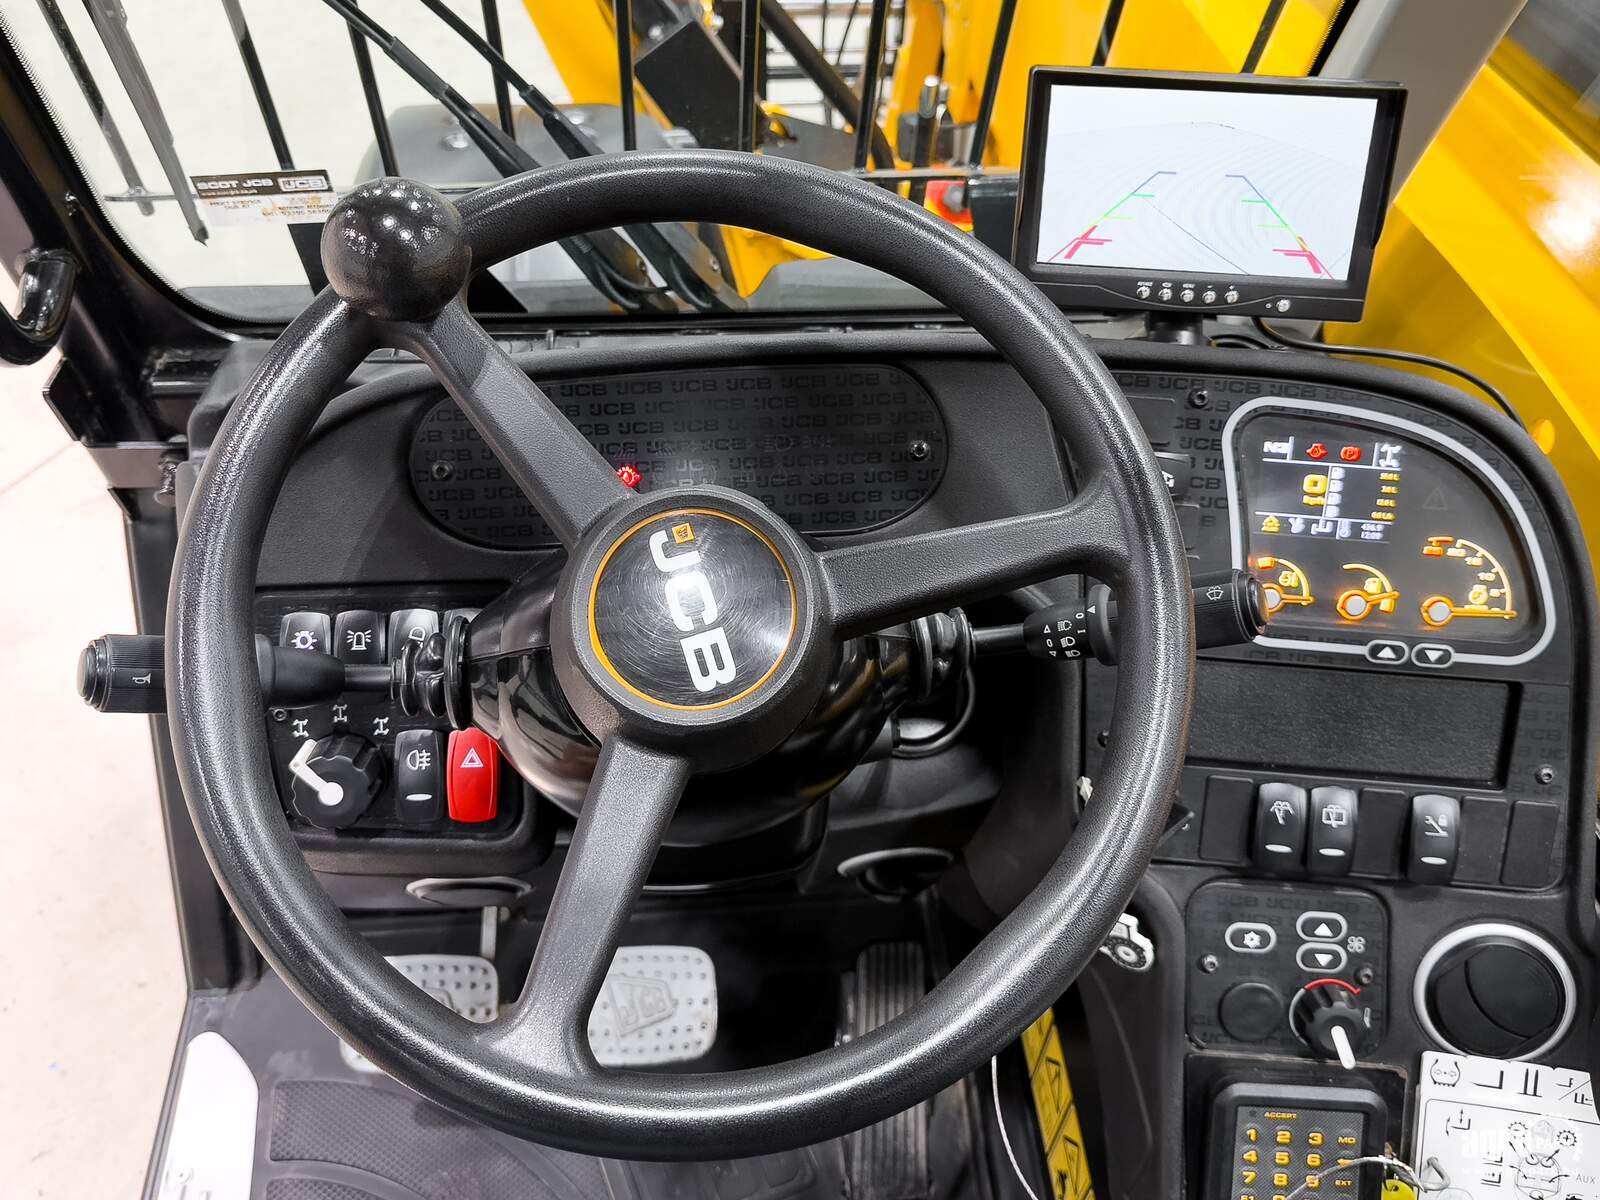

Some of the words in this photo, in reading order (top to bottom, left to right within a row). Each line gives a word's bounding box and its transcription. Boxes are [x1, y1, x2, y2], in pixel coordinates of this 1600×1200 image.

[196, 180, 239, 190] SCOT
[242, 178, 274, 187] JCB
[285, 179, 322, 189] JCB
[649, 529, 736, 692] JCB
[1264, 1112, 1297, 1120] ACCEPT
[1246, 1129, 1259, 1144] 1
[1276, 1130, 1292, 1145] 2
[1308, 1132, 1325, 1146] 3
[1242, 1150, 1258, 1164] 4
[1275, 1152, 1291, 1165] 5
[1306, 1154, 1322, 1168] 6
[1242, 1171, 1257, 1184] 7
[1273, 1173, 1289, 1187] 8
[1305, 1175, 1320, 1188] 9
[1575, 1173, 1597, 1184] AUX
